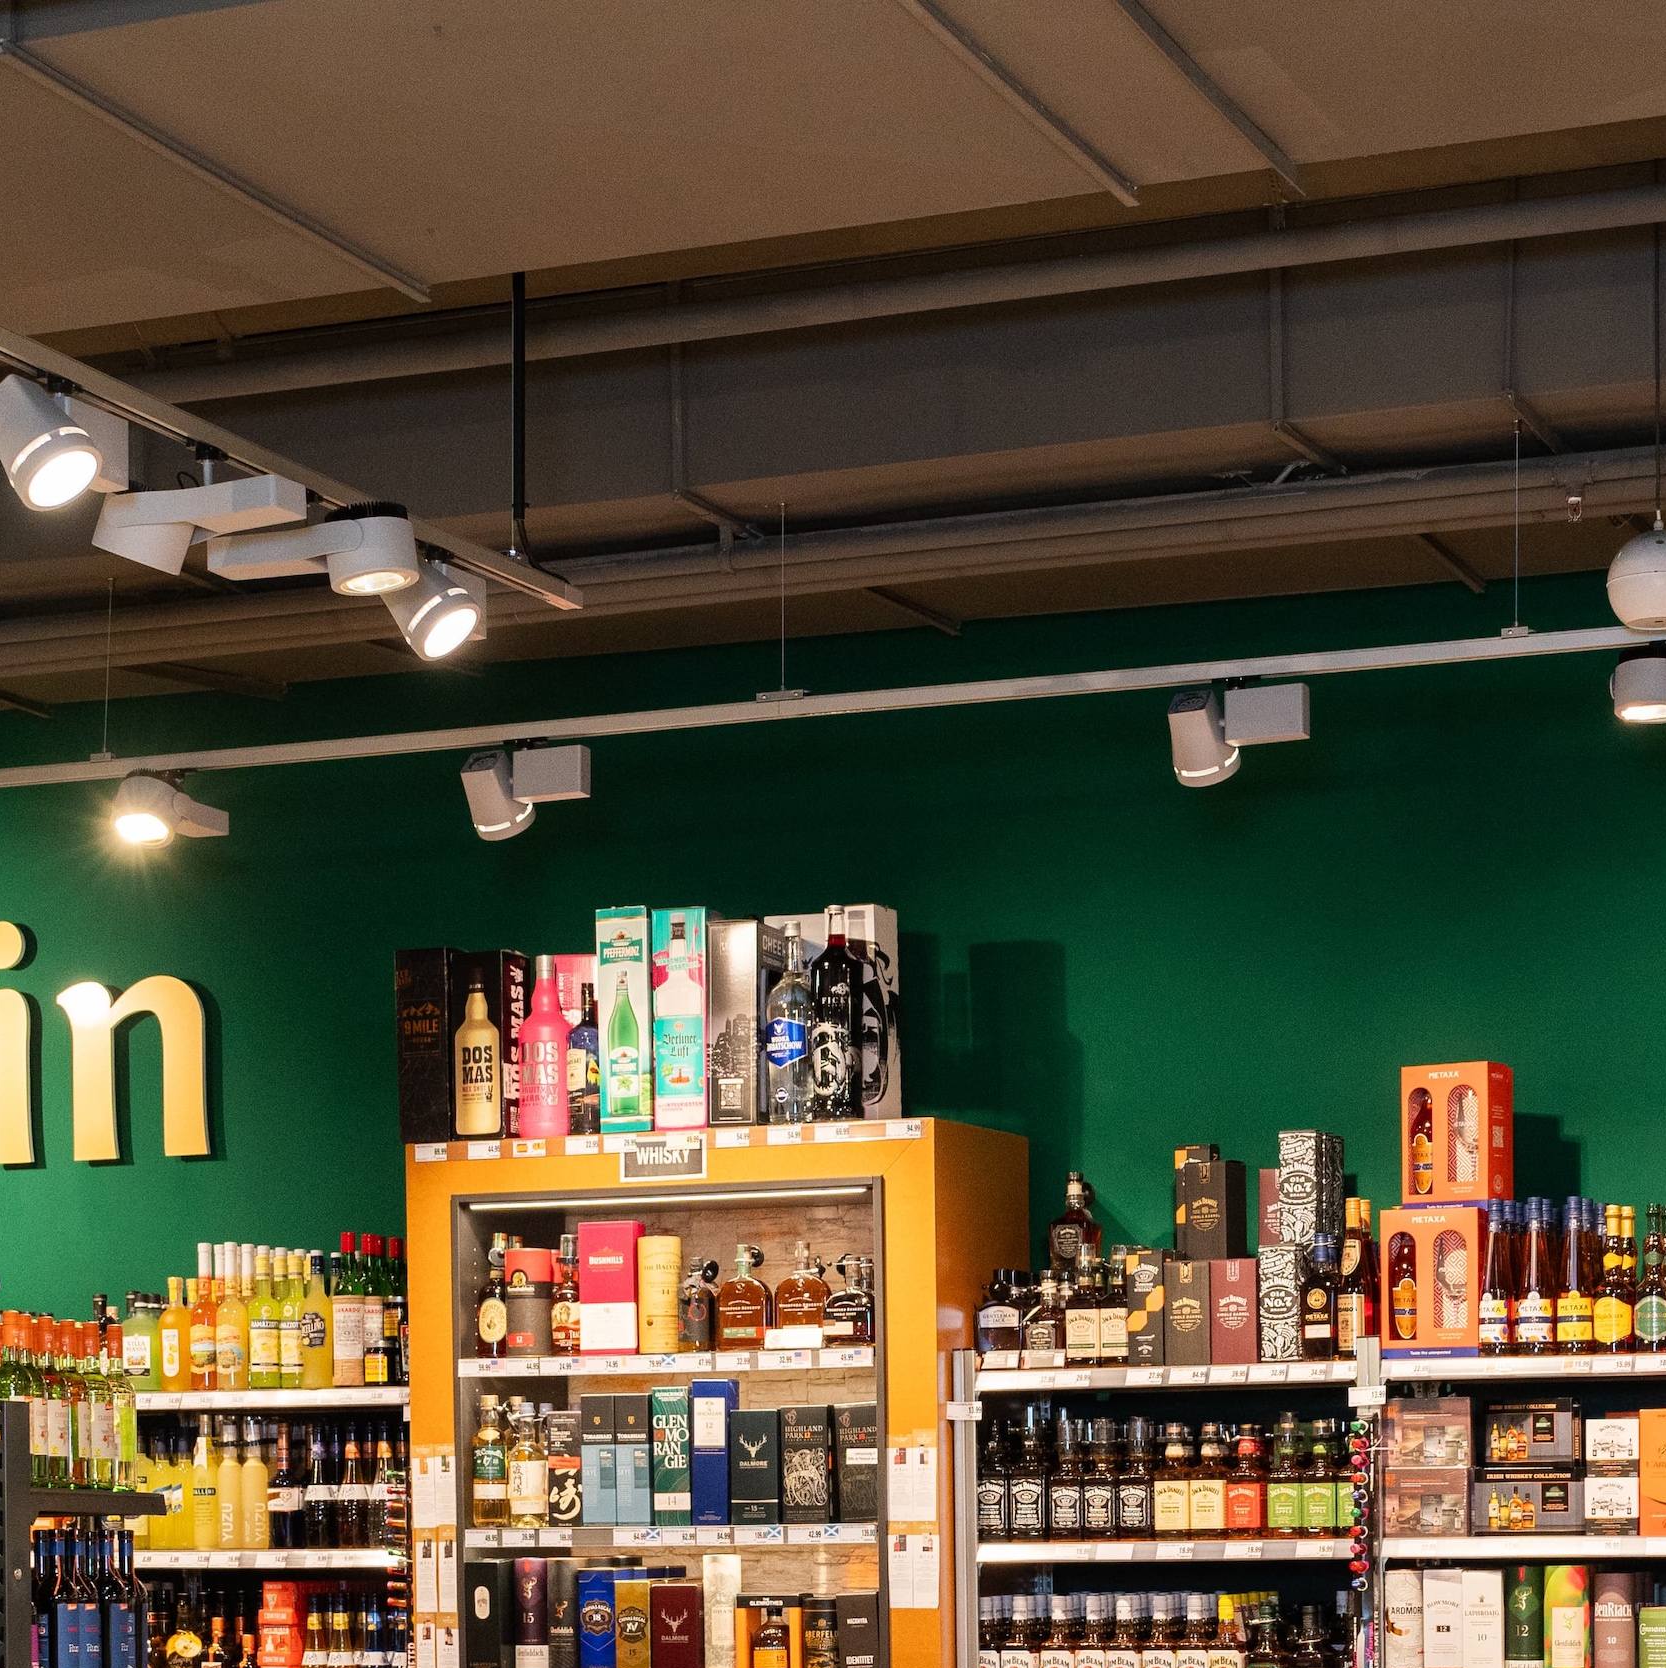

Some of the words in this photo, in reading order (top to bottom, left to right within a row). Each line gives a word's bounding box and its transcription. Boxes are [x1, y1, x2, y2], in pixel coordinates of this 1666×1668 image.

[603, 945, 639, 960] PFEFFERMINZ
[663, 1034, 696, 1044] Berliner
[461, 1047, 493, 1064] DOS
[670, 1044, 688, 1056] Luft
[461, 1066, 493, 1083] MAS
[1428, 1070, 1460, 1078] METAXA
[907, 1123, 920, 1132] 94.99
[635, 1142, 691, 1164] WHISKY
[1284, 1182, 1312, 1193] No.7
[1412, 1216, 1446, 1224] METAXA
[589, 1256, 624, 1264] BUSHMILLS
[1264, 1296, 1291, 1308] No.7
[653, 1415, 687, 1430] GLEN
[665, 1428, 689, 1443] MO
[785, 1426, 824, 1434] HIGHLAND
[653, 1441, 681, 1456] RAN
[665, 1453, 687, 1468] GIE
[222, 1501, 234, 1542] YUZU
[1390, 1606, 1423, 1614] ARDMORE
[846, 1656, 874, 1666] IDENTITET
